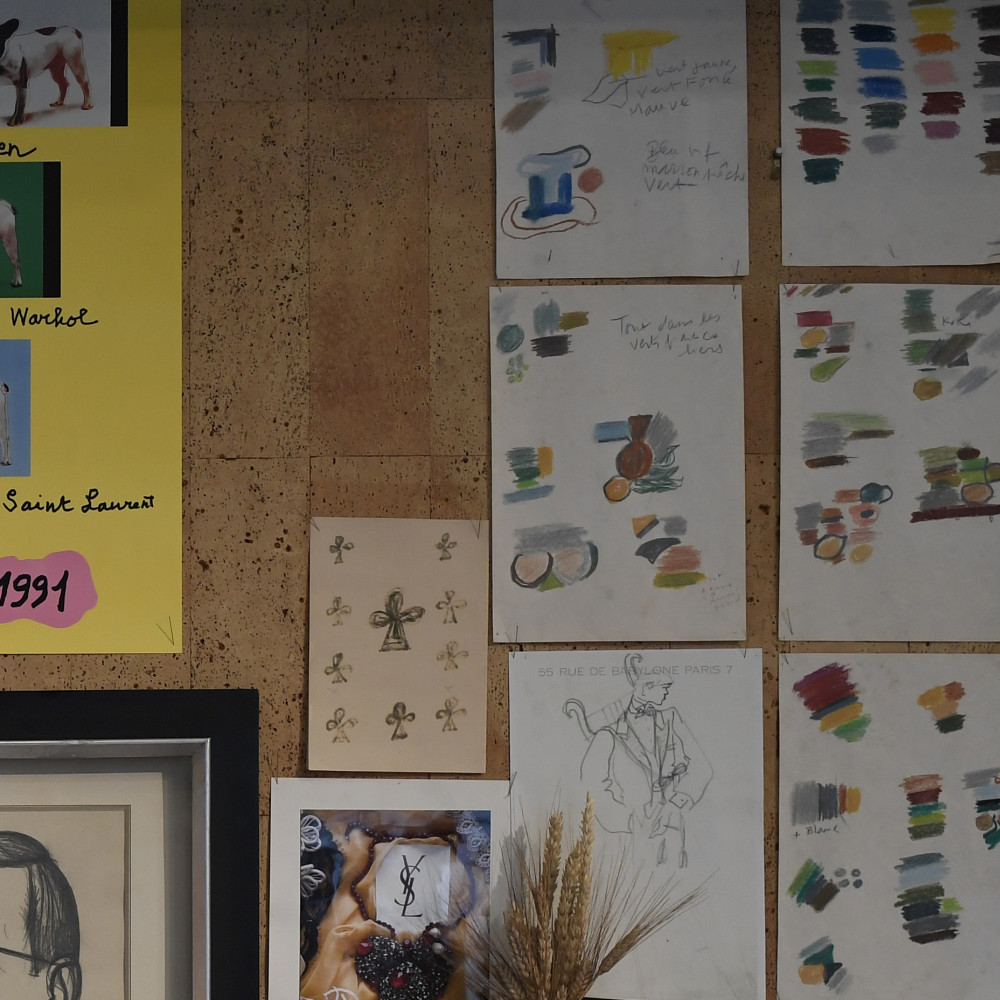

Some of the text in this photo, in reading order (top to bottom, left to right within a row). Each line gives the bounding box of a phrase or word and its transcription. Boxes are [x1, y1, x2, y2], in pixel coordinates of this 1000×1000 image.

[10, 307, 99, 327] Warhol
[2, 488, 75, 513] Saint
[81, 488, 154, 513] Laurent
[538, 665, 733, 677] 55 RUE DE BABYLONE PARIS 7
[393, 854, 427, 918] YSL
